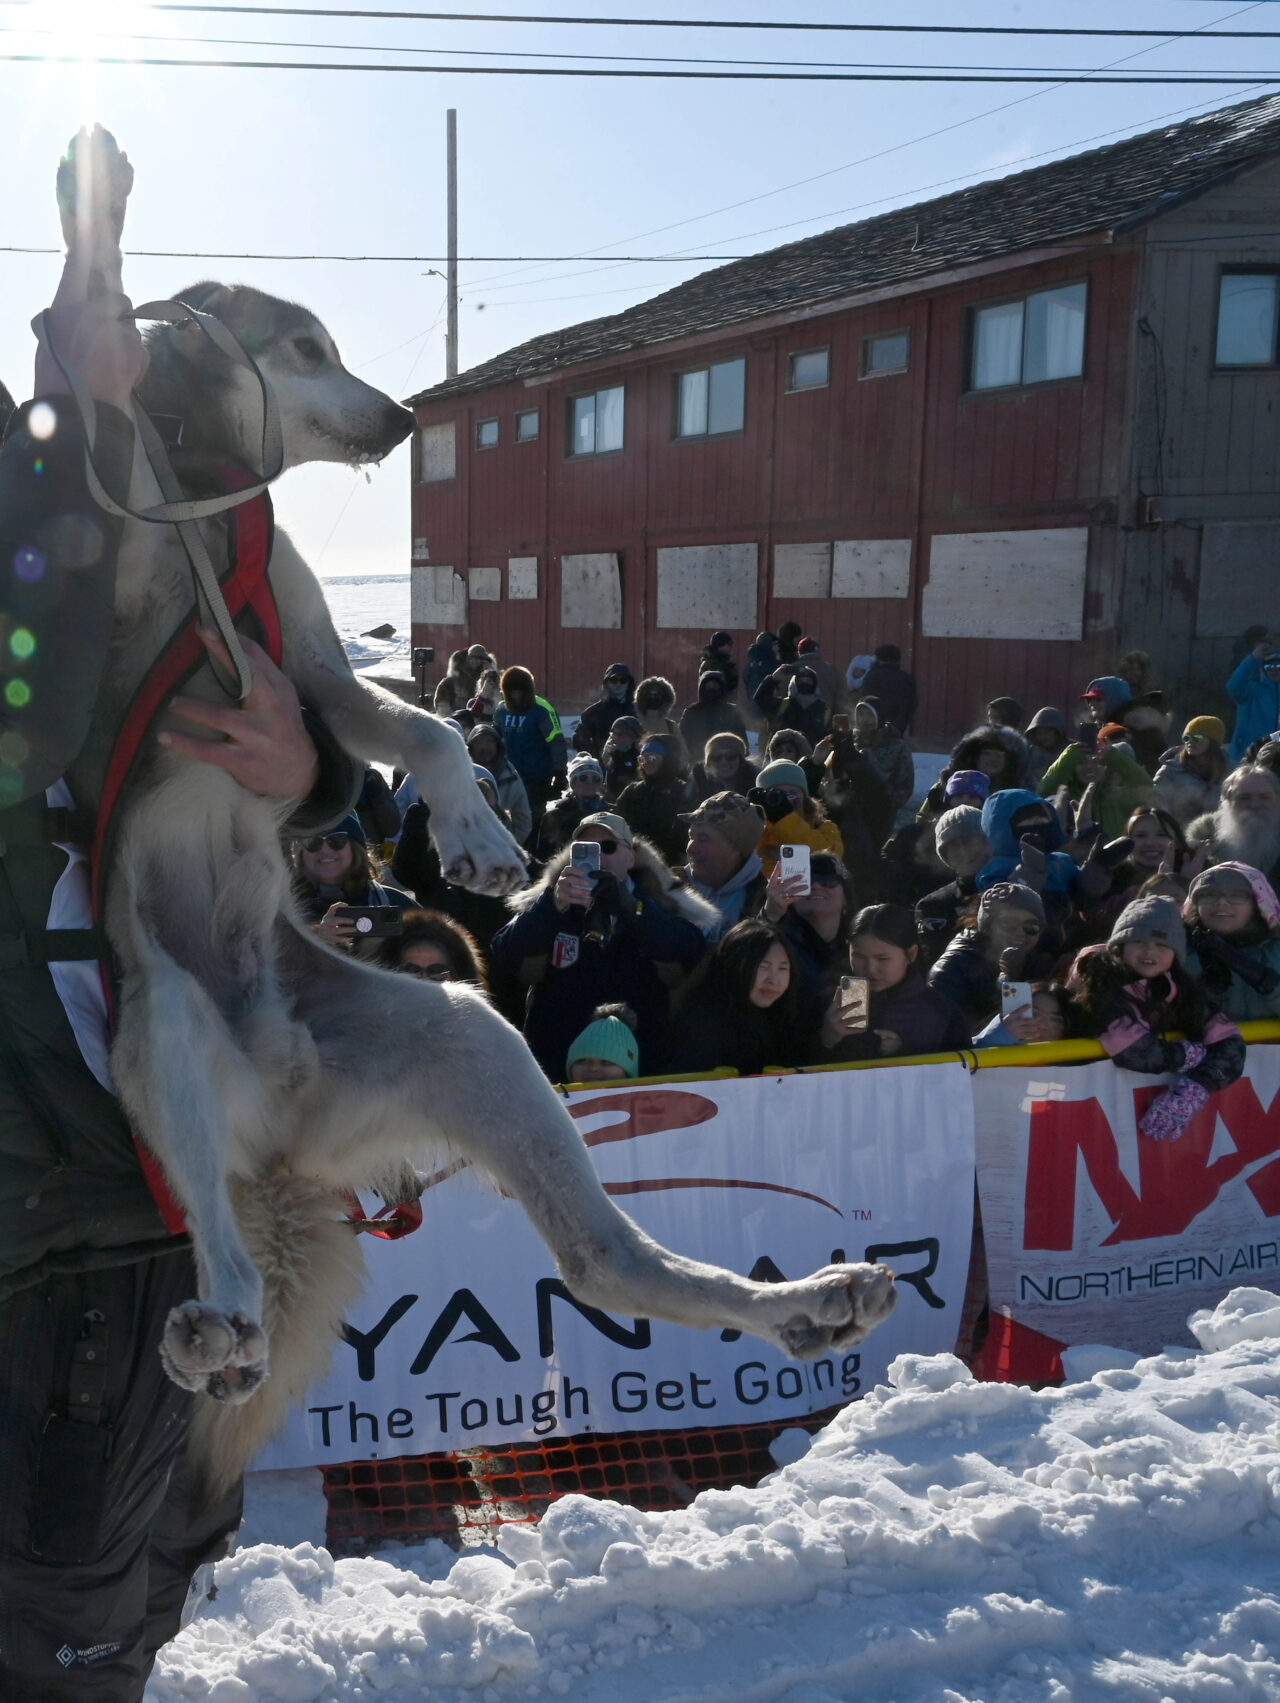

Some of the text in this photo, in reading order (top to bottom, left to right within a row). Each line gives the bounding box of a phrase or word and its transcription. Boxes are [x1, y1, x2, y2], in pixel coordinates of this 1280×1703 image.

[505, 714, 526, 728] FLY
[1023, 1076, 1280, 1251] NA
[852, 1209, 872, 1221] TM
[1021, 1241, 1280, 1301] NORTHERN AIR
[338, 1277, 652, 1382] YAN
[308, 1401, 414, 1447] The
[425, 1377, 589, 1435] Tough
[611, 1371, 718, 1413] Get
